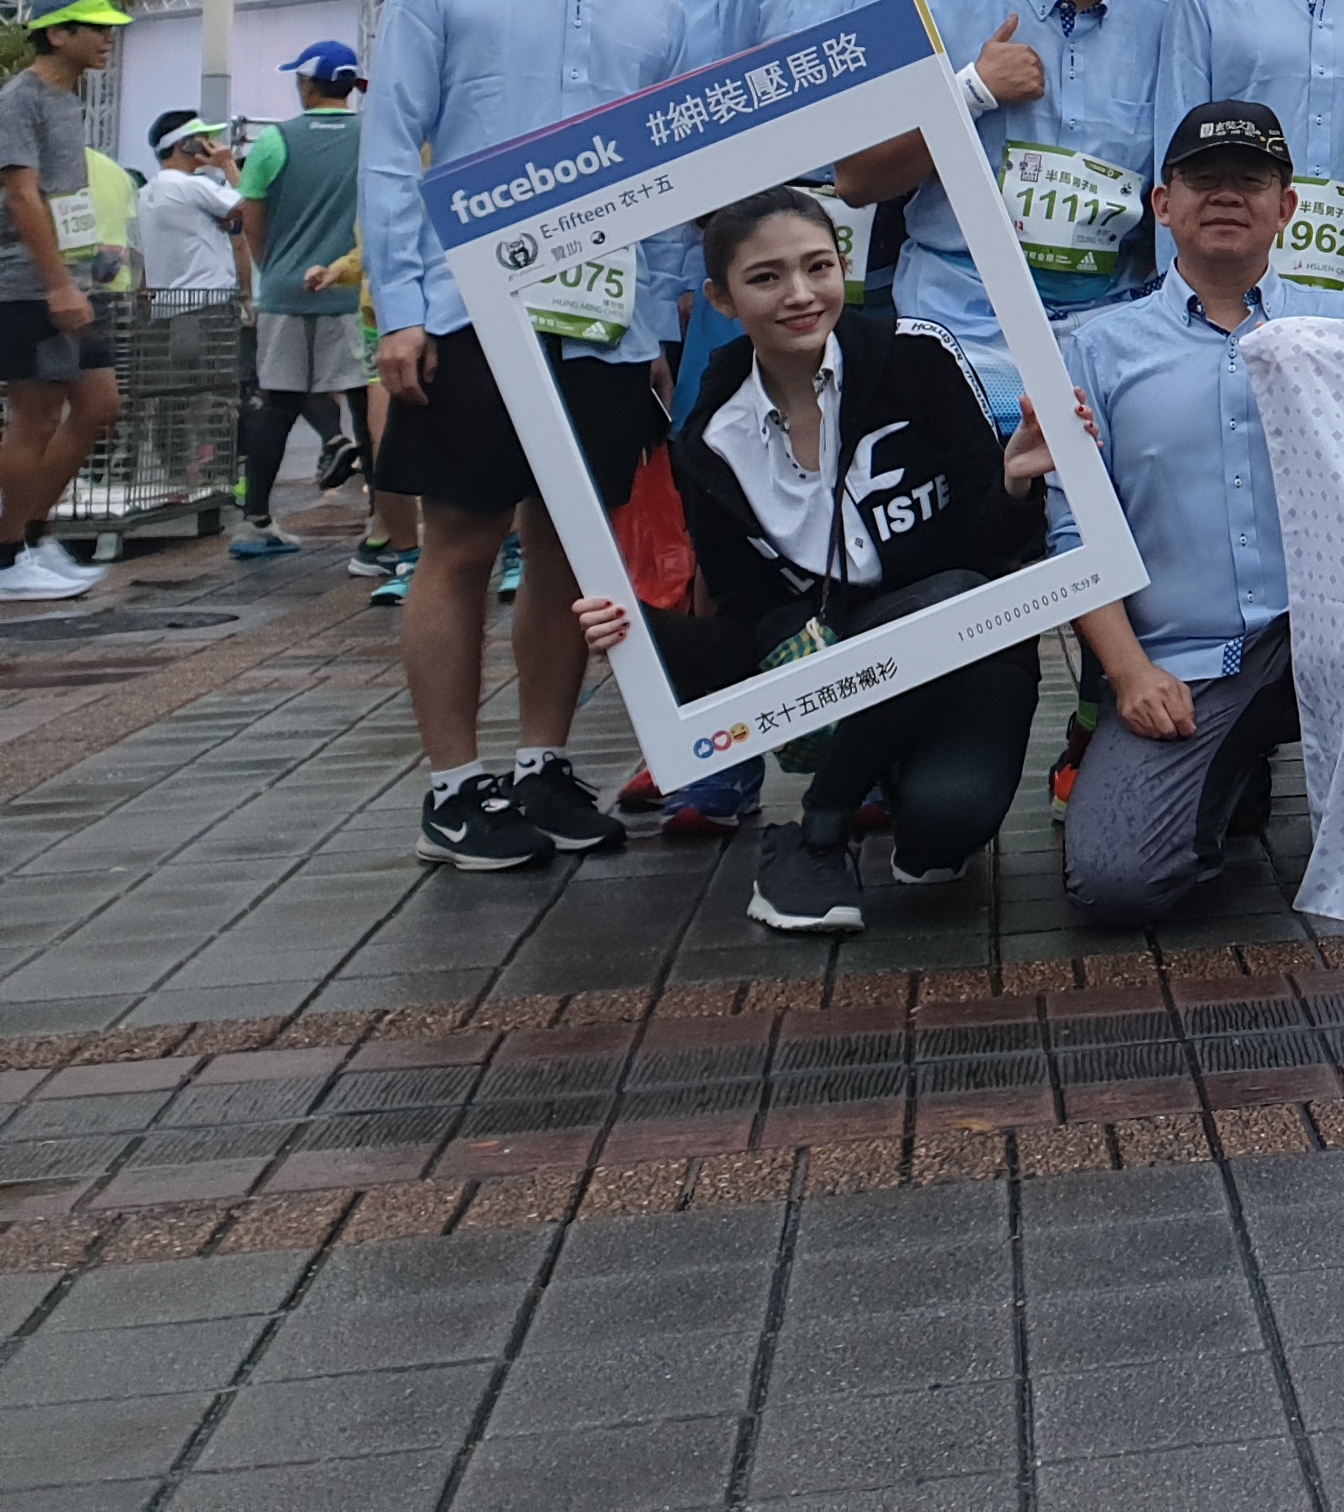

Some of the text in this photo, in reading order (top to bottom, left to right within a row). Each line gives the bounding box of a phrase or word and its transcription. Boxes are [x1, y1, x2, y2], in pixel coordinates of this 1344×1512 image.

[646, 32, 868, 147] #紳裝壓馬路
[451, 136, 623, 224] facebook
[540, 175, 674, 239] E-fifteen 衣十五
[1017, 188, 1127, 226] 11117
[912, 322, 963, 361] HOLLISTER
[755, 657, 898, 734] 衣十五商務襯衫
